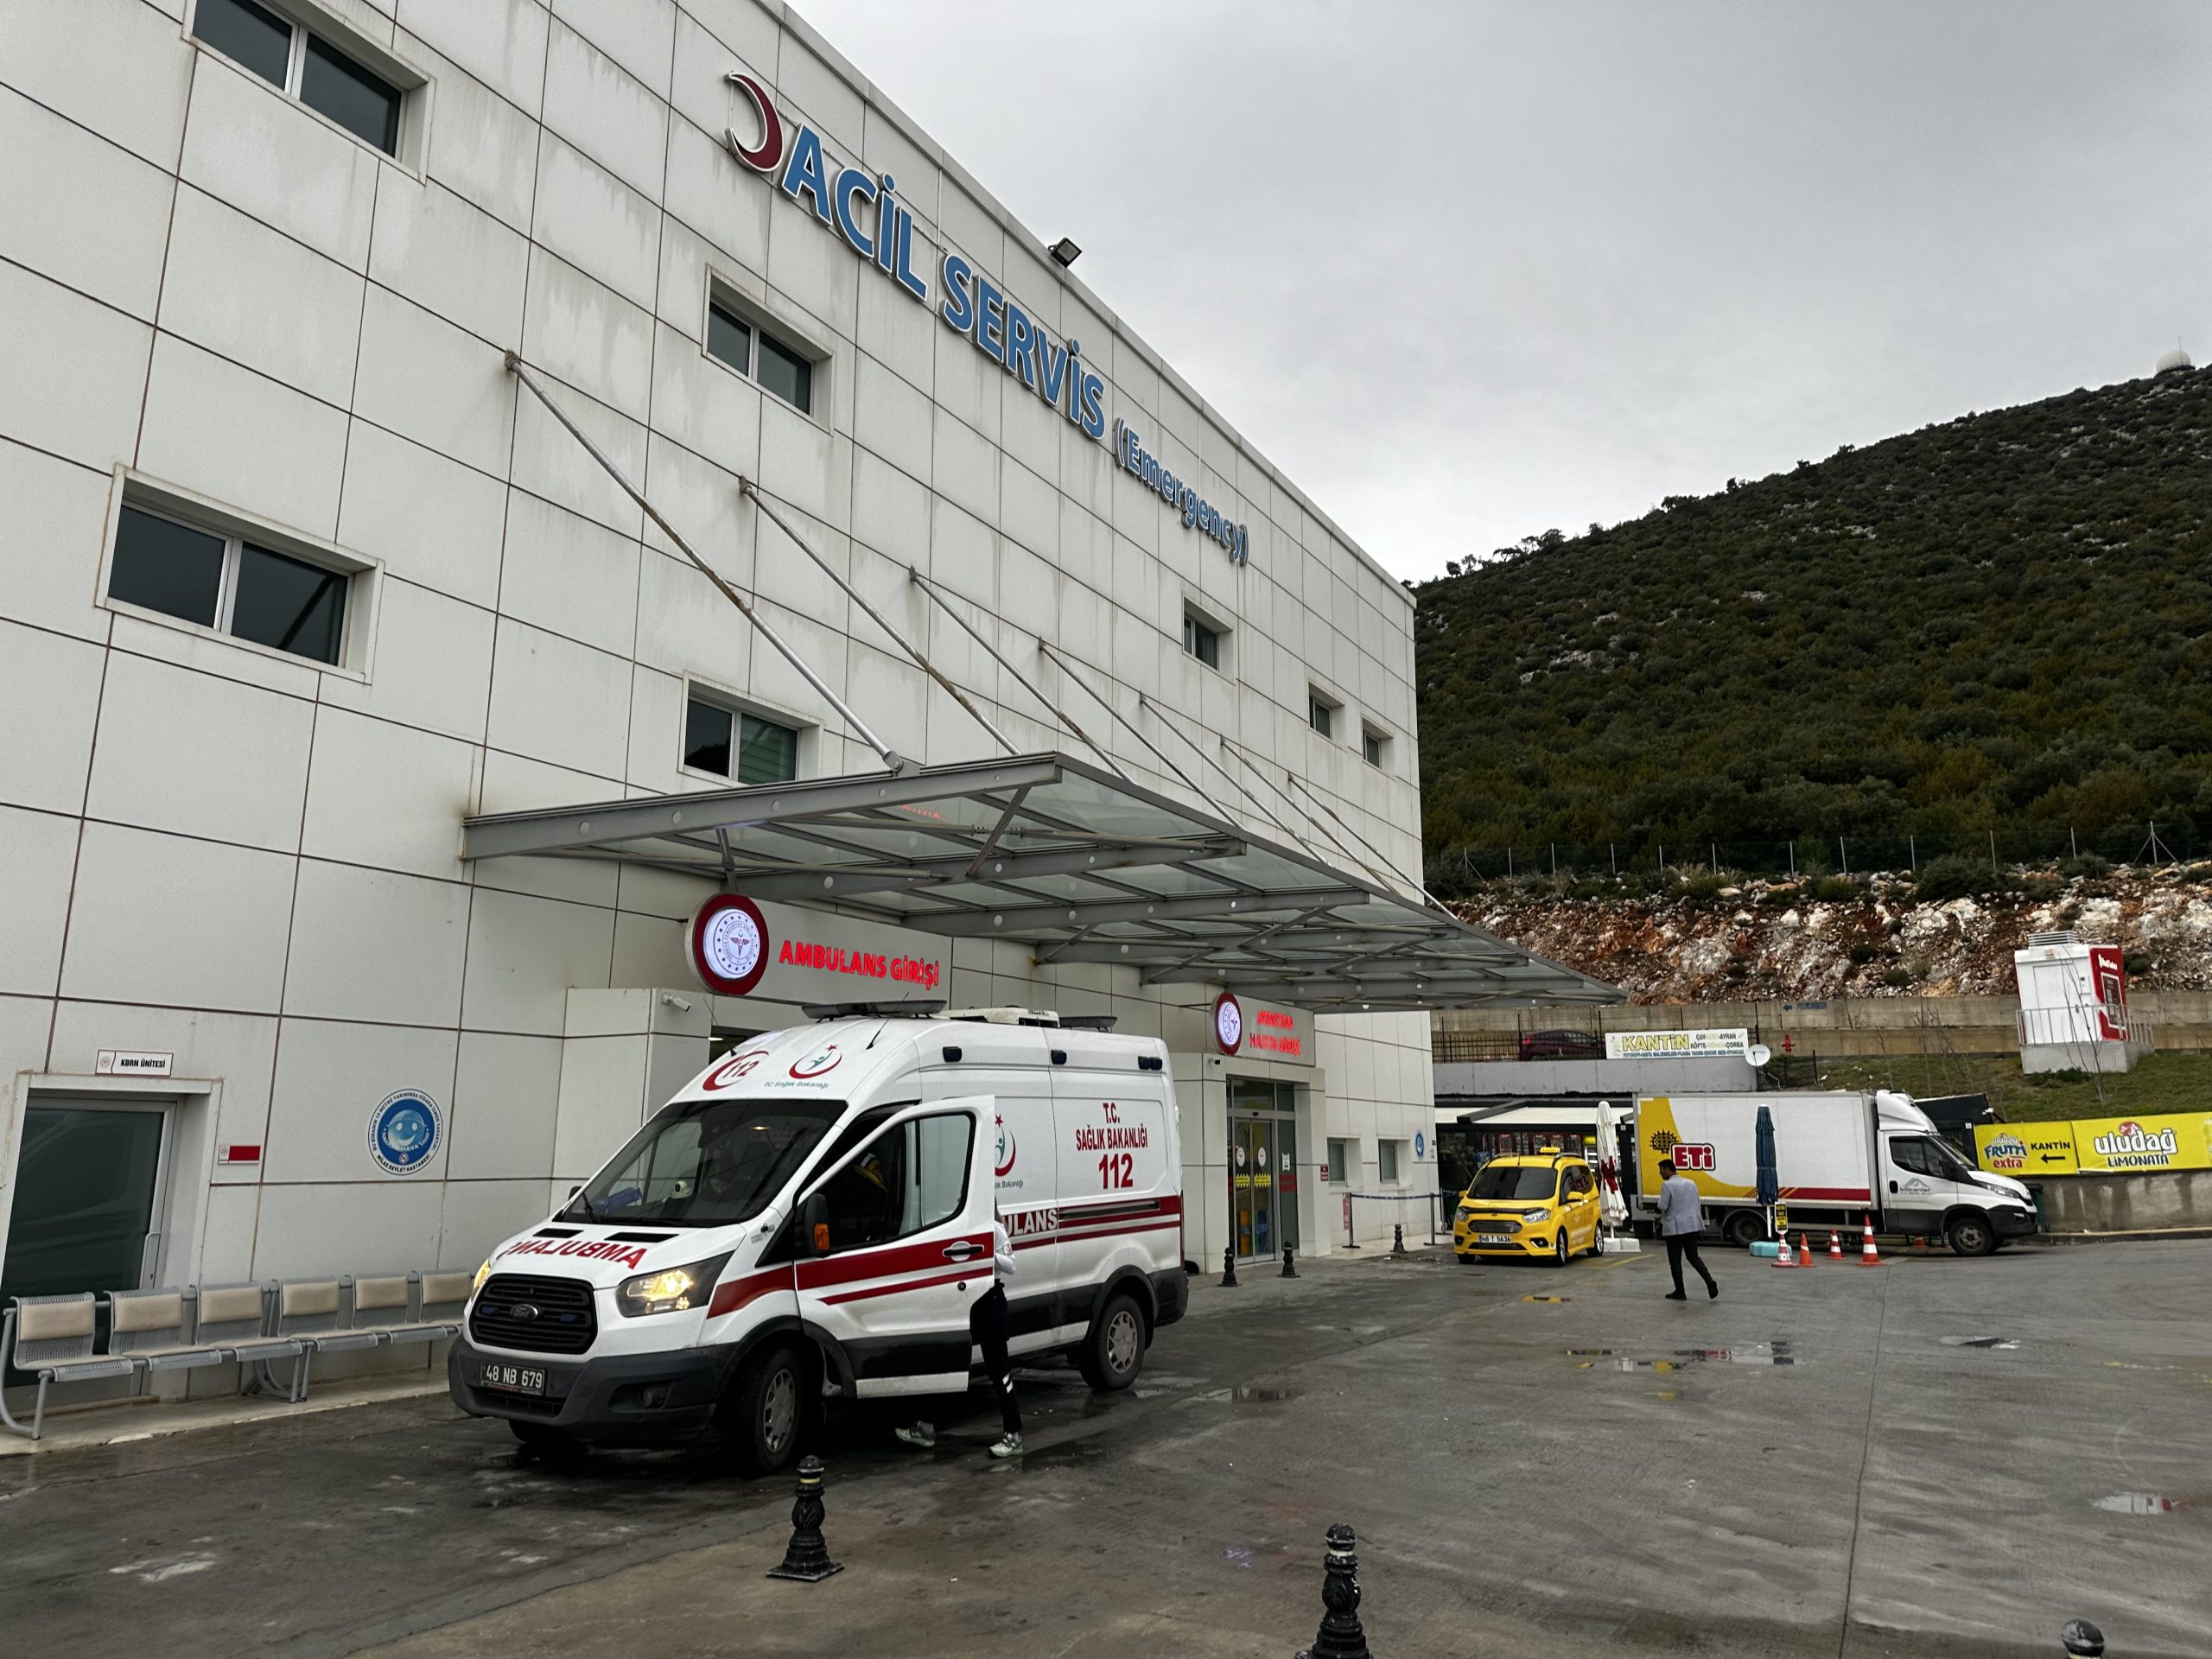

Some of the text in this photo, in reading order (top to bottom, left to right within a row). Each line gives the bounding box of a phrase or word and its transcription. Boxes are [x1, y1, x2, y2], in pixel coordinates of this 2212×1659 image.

[779, 123, 1249, 567] ACİL SERVİS (Emergency)
[779, 939, 887, 979] AMBULANS
[890, 954, 939, 991] GİRİŞİ
[120, 1058, 166, 1068] KBRN ÜNİTESİ
[722, 1059, 760, 1078] 112
[1103, 1102, 1120, 1124] T.C.
[1076, 1122, 1148, 1151] SAĞLIK BAKANLIĞI
[2031, 1140, 2071, 1151] KANTİN
[2094, 1127, 2179, 1154] uludağ
[406, 1153, 431, 1172] HASTANESİ
[1098, 1153, 1134, 1190] 112
[1993, 1157, 2023, 1168] extra
[486, 1363, 499, 1382] 48
[503, 1367, 518, 1385] NB
[521, 1370, 543, 1389] 679
